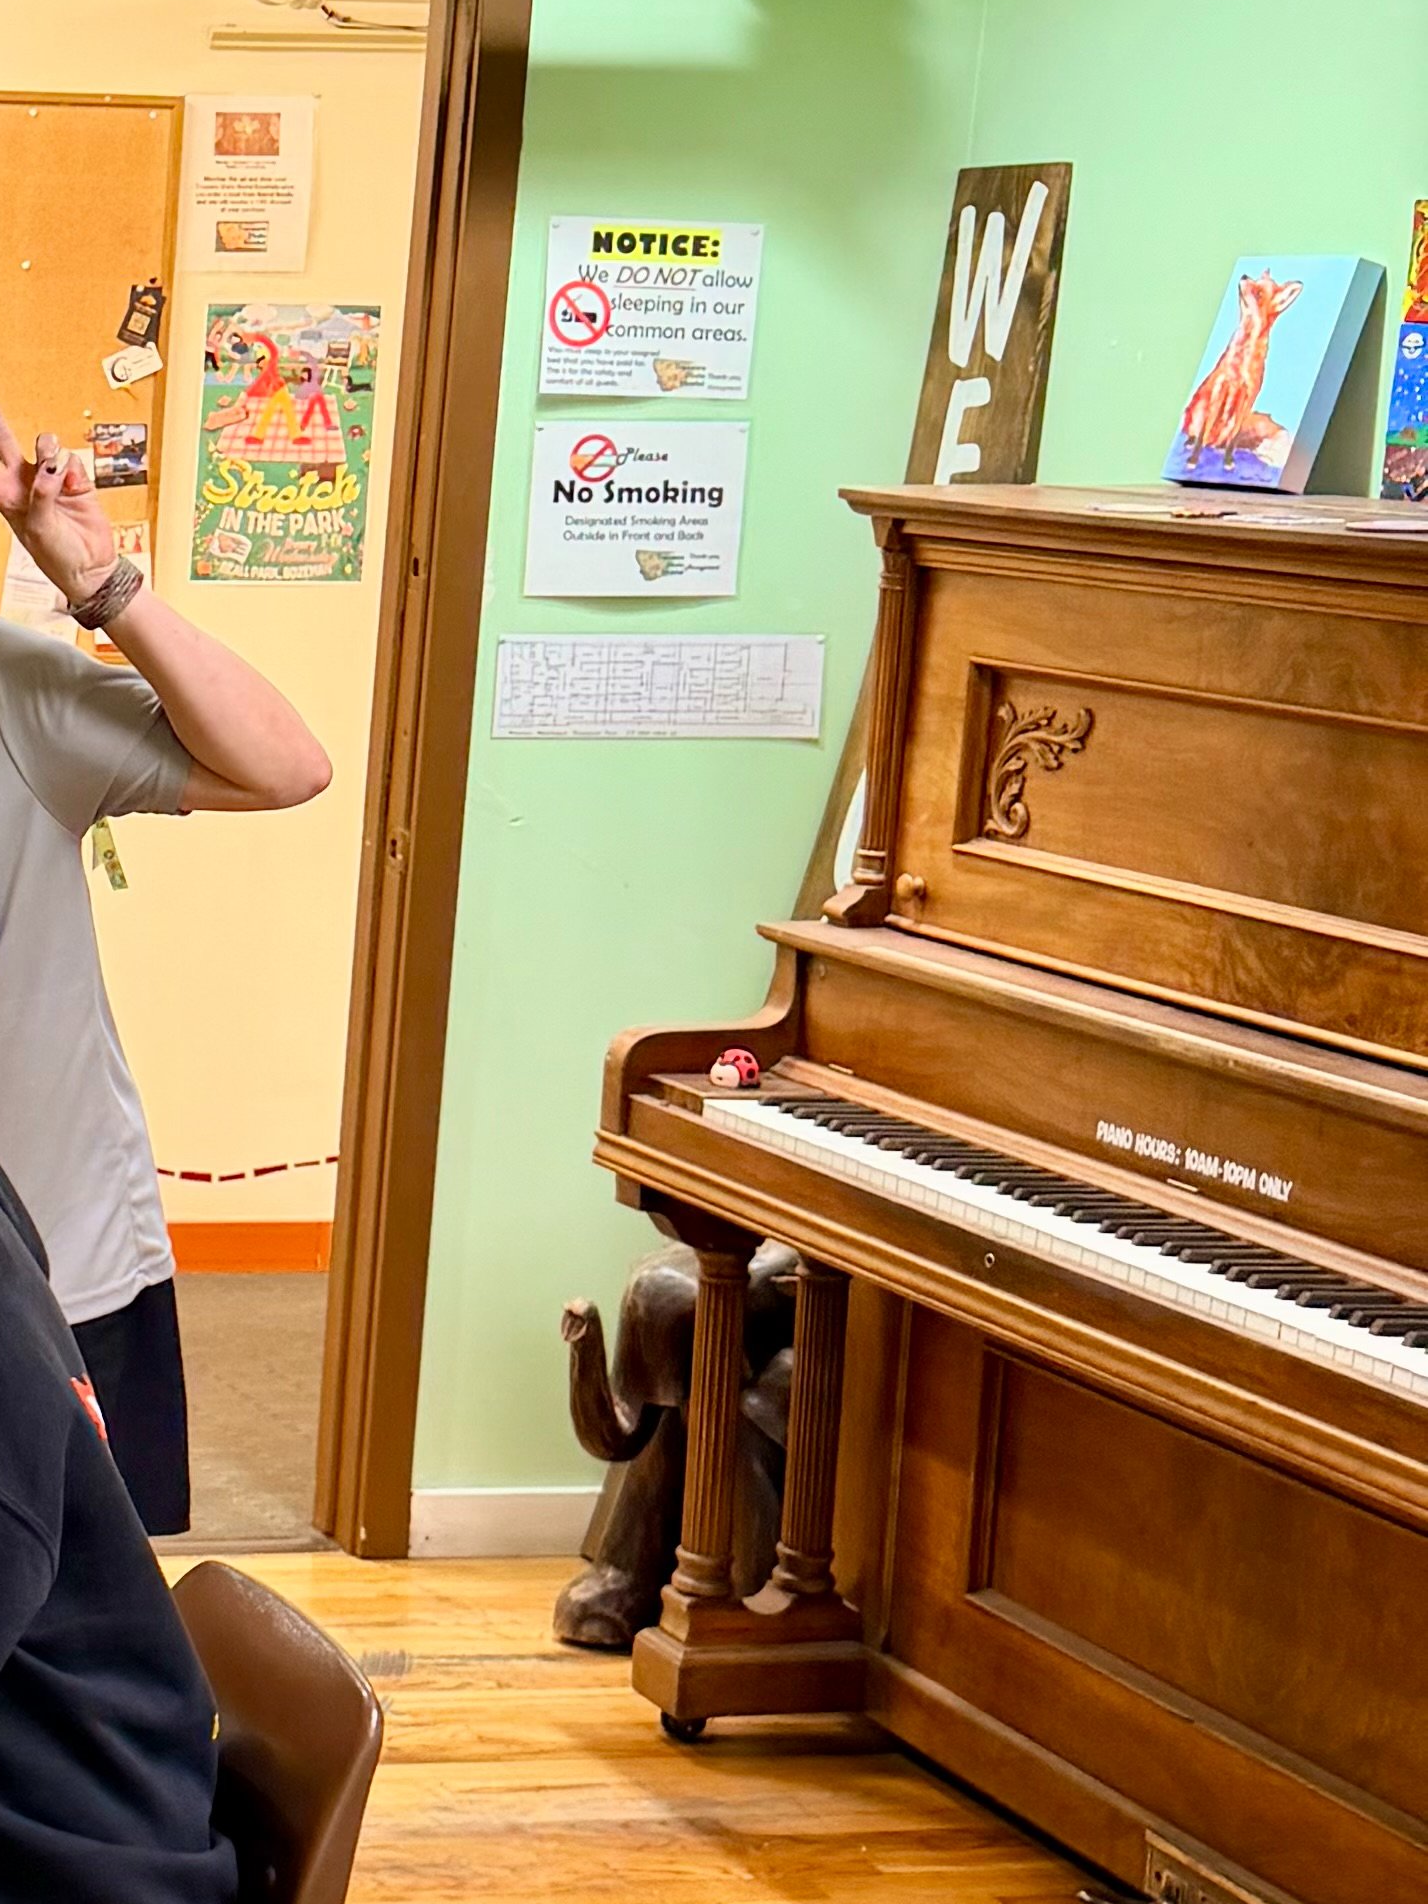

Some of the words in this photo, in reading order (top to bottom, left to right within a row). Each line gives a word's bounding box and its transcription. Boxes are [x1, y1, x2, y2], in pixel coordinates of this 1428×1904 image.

[593, 231, 720, 258] NOTICE:
[579, 264, 609, 283] We
[616, 266, 649, 284] DO
[654, 267, 702, 286] NOT
[702, 270, 753, 288] allow
[611, 293, 684, 315] sleeping
[690, 297, 707, 314] in
[713, 301, 745, 315] our
[605, 324, 685, 339] common
[692, 327, 747, 342] areas.
[616, 447, 668, 467] Please
[553, 480, 593, 504] No
[603, 479, 724, 508] Smoking
[220, 506, 243, 531] IN
[246, 510, 286, 536] THE
[289, 508, 345, 536] PARK
[565, 515, 627, 527] Designated
[631, 516, 676, 527] Smoking
[679, 516, 709, 526] Areas
[563, 530, 605, 541] Outside
[609, 530, 618, 541] in
[622, 530, 650, 541] Front
[653, 531, 674, 541] and
[1096, 1120, 1133, 1149] PIANO
[1135, 1133, 1181, 1165] HOURS:
[1185, 1147, 1256, 1190] 10AM-10PM
[1259, 1172, 1293, 1203] ONLY
